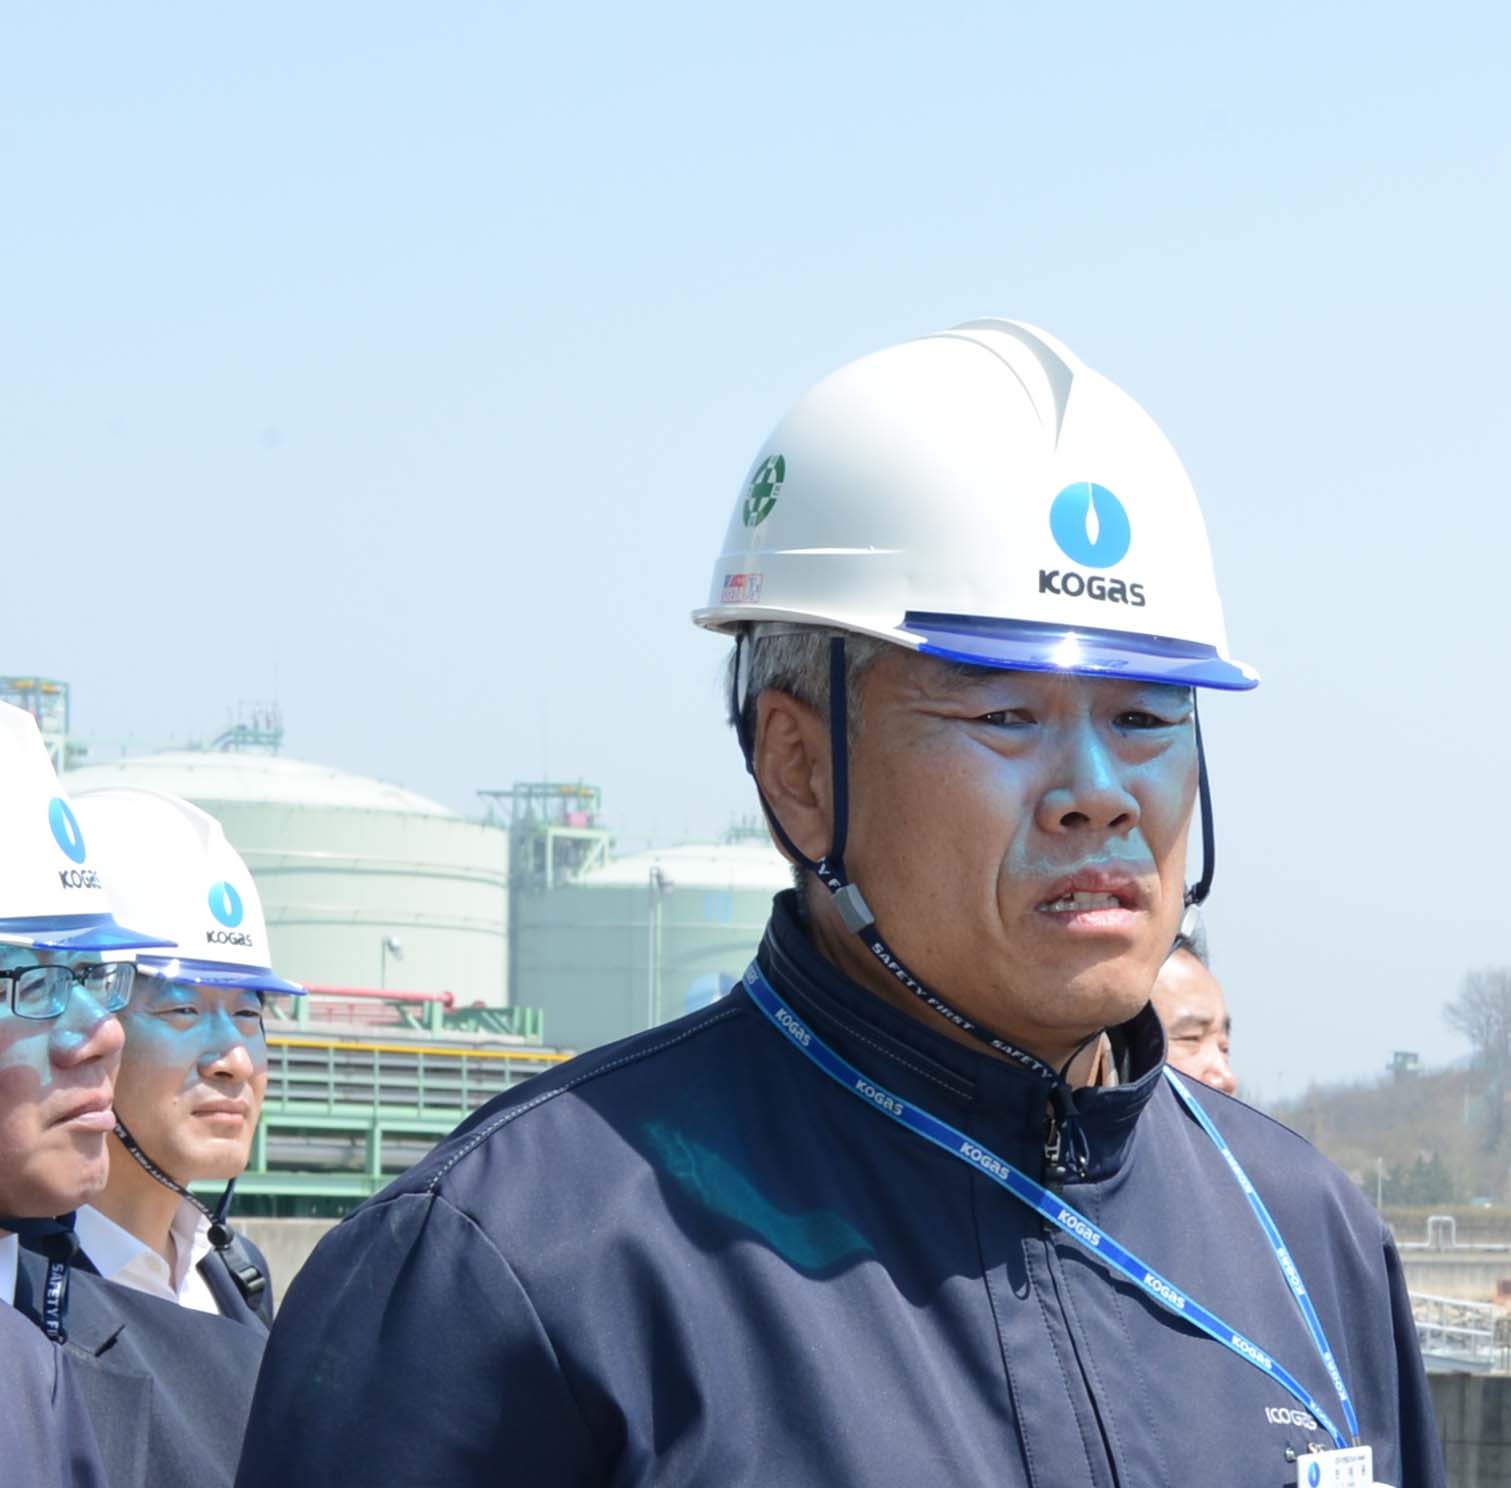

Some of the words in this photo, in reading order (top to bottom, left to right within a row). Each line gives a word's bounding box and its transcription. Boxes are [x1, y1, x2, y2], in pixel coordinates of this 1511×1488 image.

[871, 942, 927, 997] SAFETY
[928, 998, 975, 1031] FIRST
[990, 1039, 1053, 1079] SAFETY
[47, 1263, 65, 1318] SAFETY
